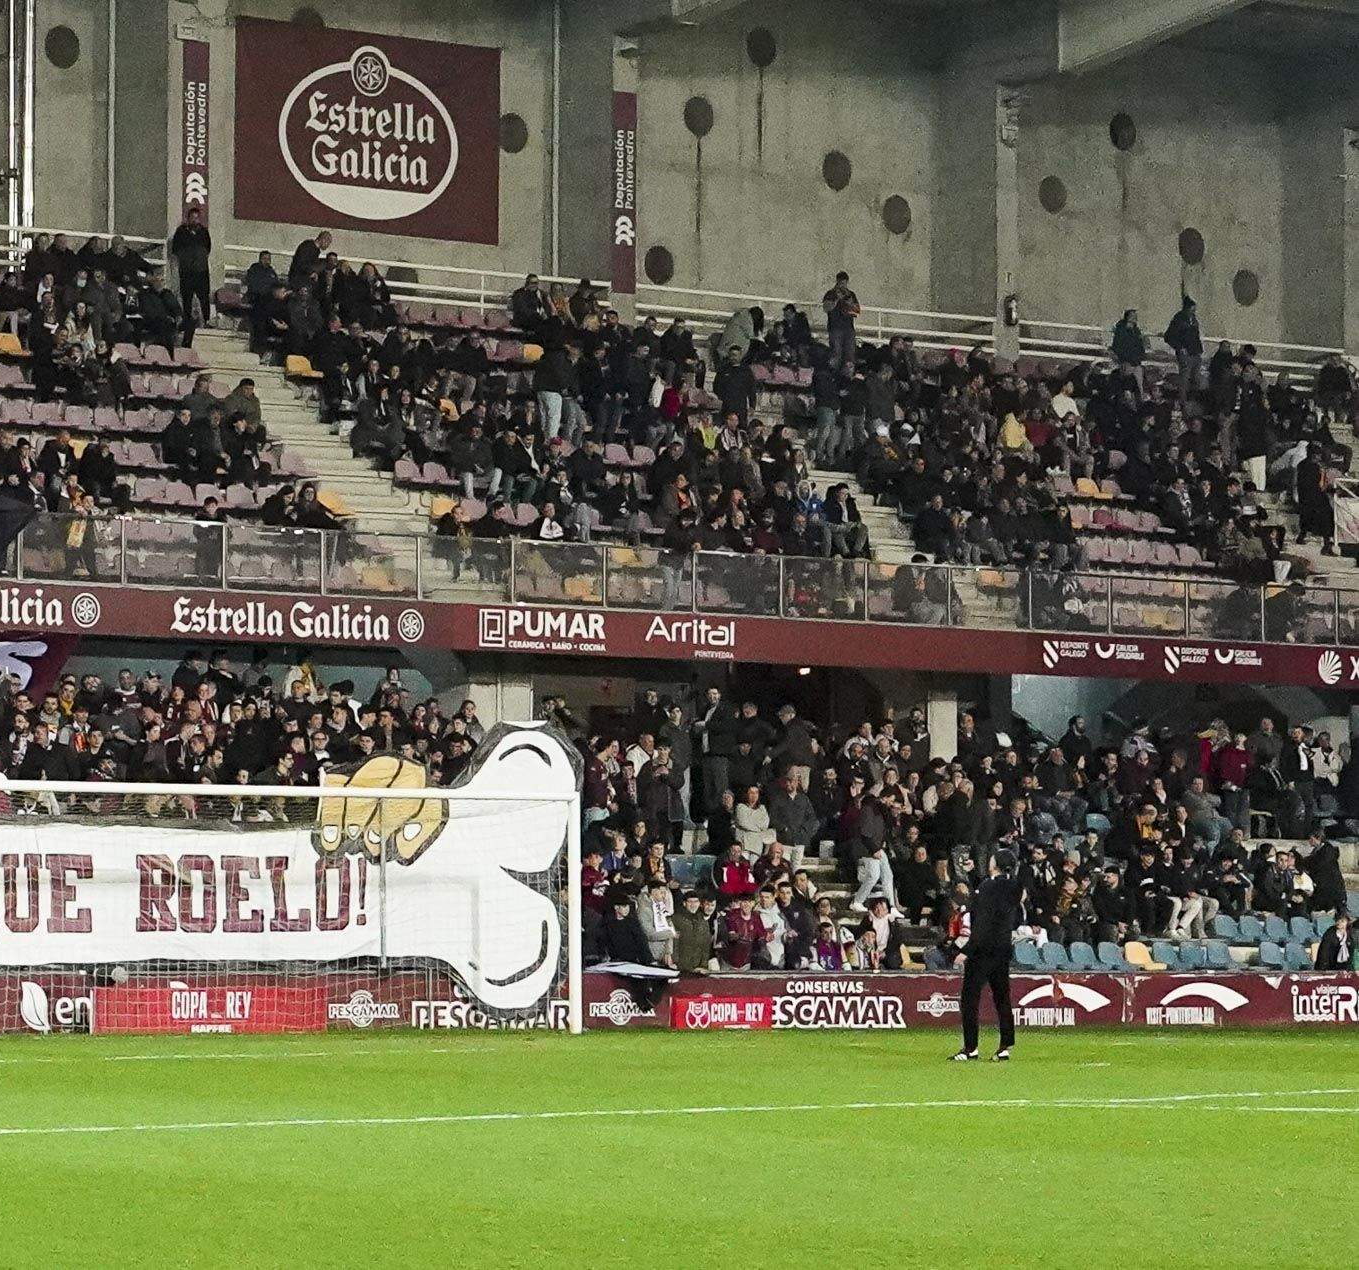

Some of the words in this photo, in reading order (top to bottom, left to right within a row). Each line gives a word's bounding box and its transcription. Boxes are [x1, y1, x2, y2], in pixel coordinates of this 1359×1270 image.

[185, 81, 197, 165] Deputación
[196, 82, 207, 166] Pontevedra
[304, 90, 436, 145] Estrella
[311, 133, 429, 186] Galicia
[170, 596, 284, 637] Estrella
[290, 600, 391, 641] Galicia
[509, 610, 606, 639] PUMAR
[645, 616, 735, 646] Arrital
[135, 854, 367, 933] ROELO!
[172, 991, 207, 1019] COPA
[226, 991, 252, 1019] REY
[786, 981, 864, 993] CONSERVAS
[328, 1002, 399, 1018] PESCAMAR
[711, 1003, 737, 1022] COPA
[745, 1003, 764, 1022] REY
